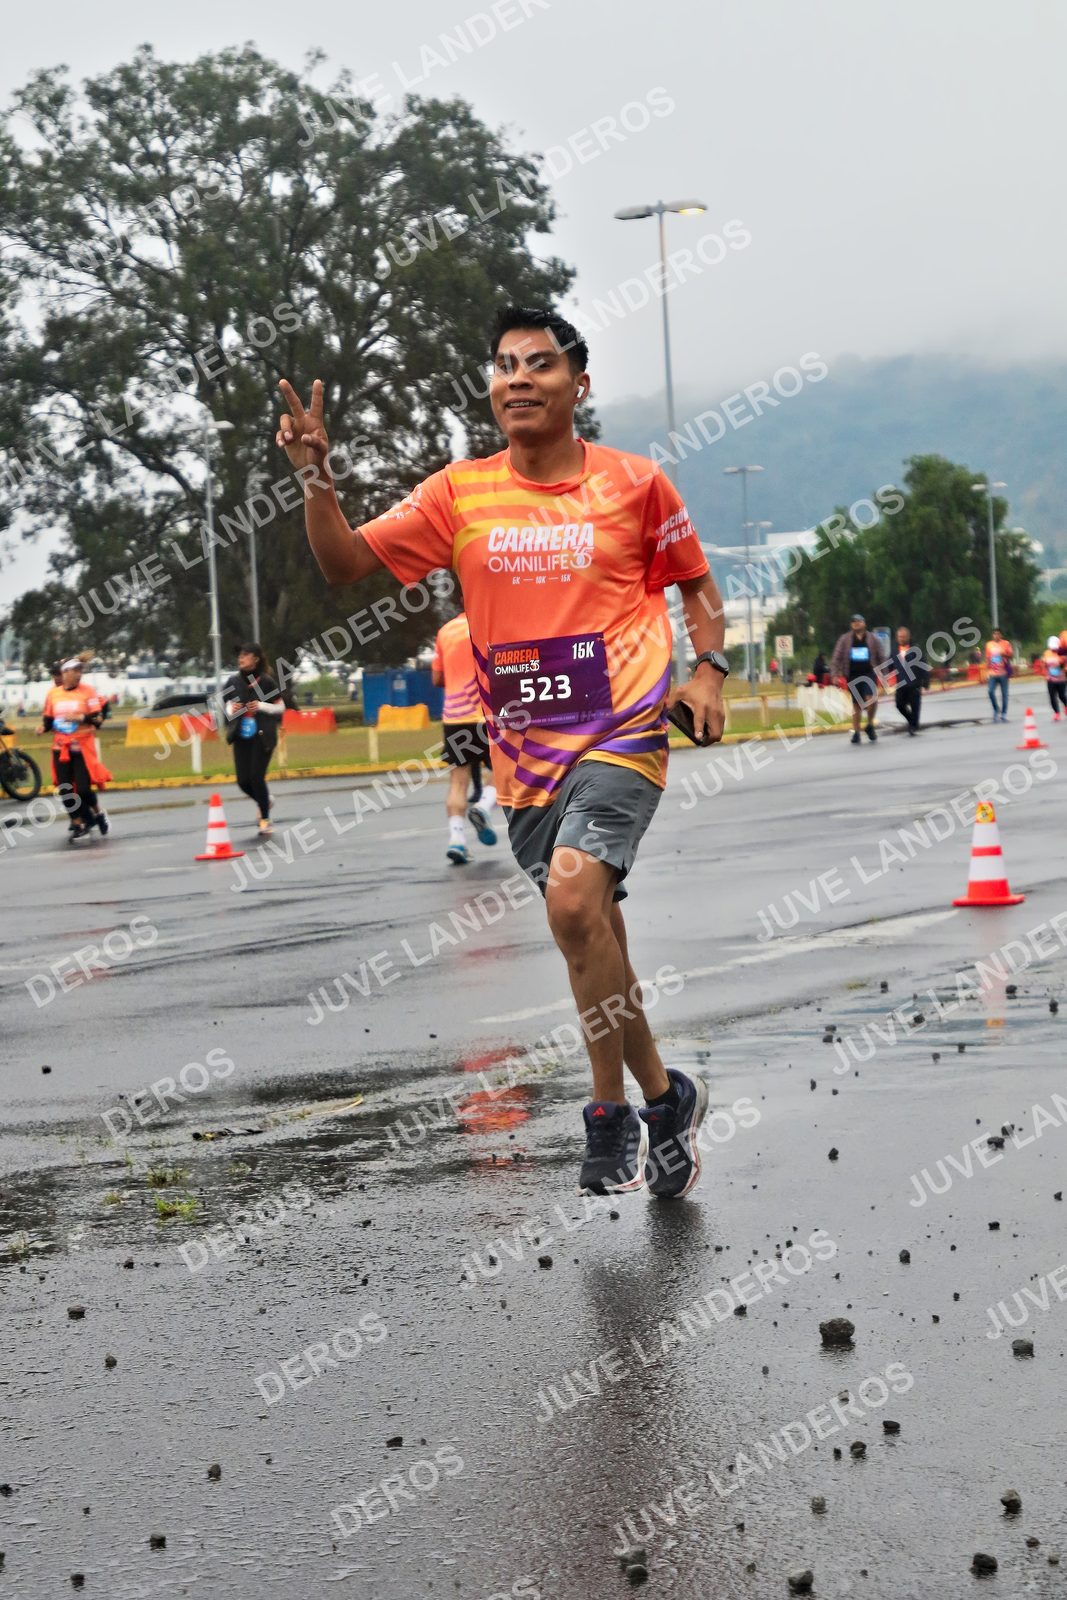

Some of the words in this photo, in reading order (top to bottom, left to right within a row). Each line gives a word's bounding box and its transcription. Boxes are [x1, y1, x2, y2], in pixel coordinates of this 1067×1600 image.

[488, 522, 595, 552] CARRERA
[488, 553, 569, 573] OMNILIFE
[494, 648, 540, 666] CARRERA
[572, 641, 595, 660] 15K
[494, 663, 530, 675] OMNILIFE
[520, 674, 572, 703] 523
